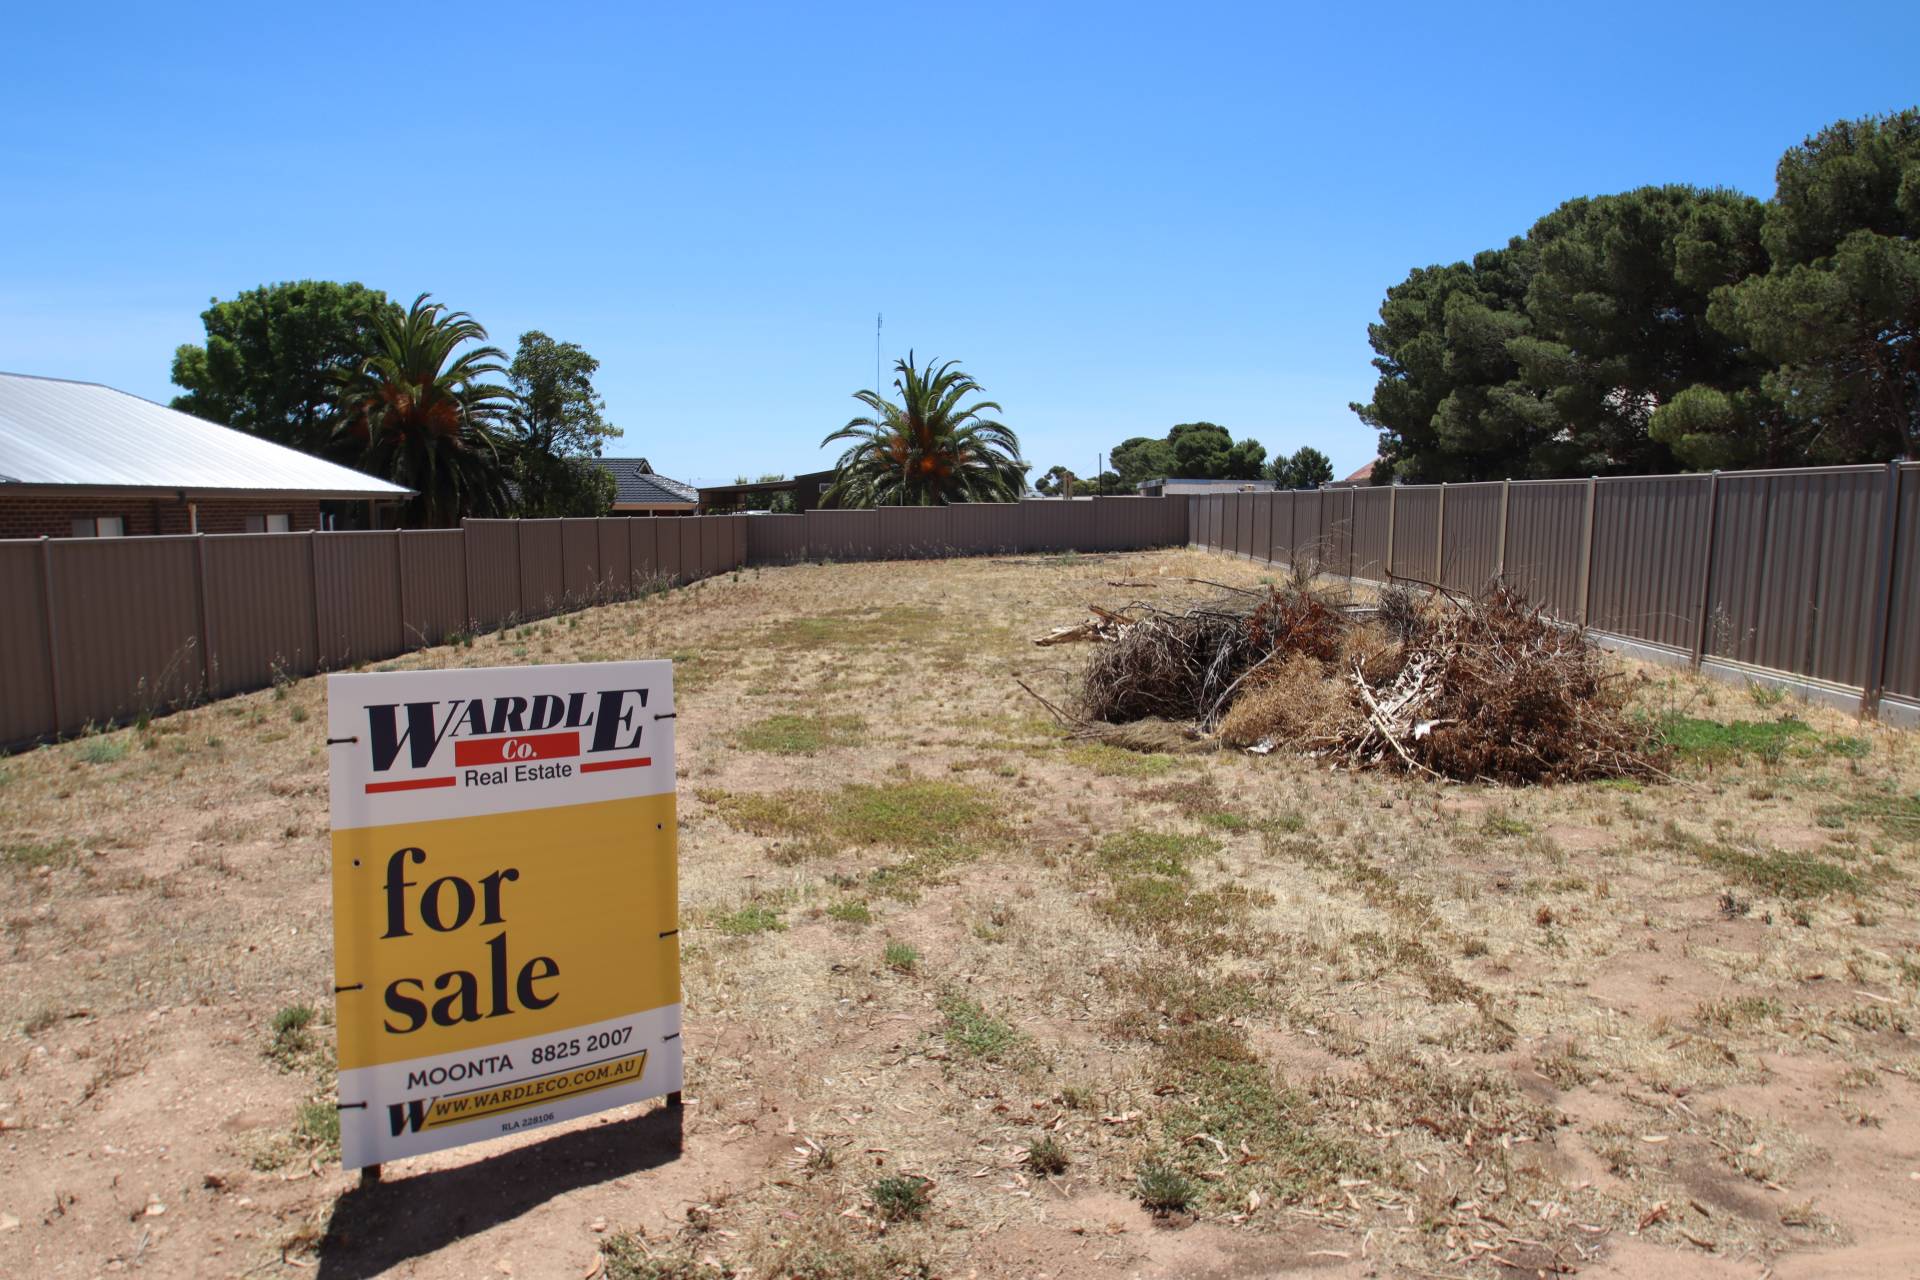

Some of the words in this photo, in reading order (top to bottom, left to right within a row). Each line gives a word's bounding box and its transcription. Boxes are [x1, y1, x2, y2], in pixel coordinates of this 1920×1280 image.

[363, 688, 650, 772] WARDLE
[502, 739, 537, 760] Co.
[465, 766, 508, 787] Real
[515, 762, 572, 782] Estate
[379, 847, 520, 940] for
[383, 931, 560, 1034] sale
[406, 1054, 513, 1089] MOONTA
[531, 1039, 581, 1064] 8825
[586, 1027, 633, 1052] 2007
[502, 1121, 520, 1131] RLA
